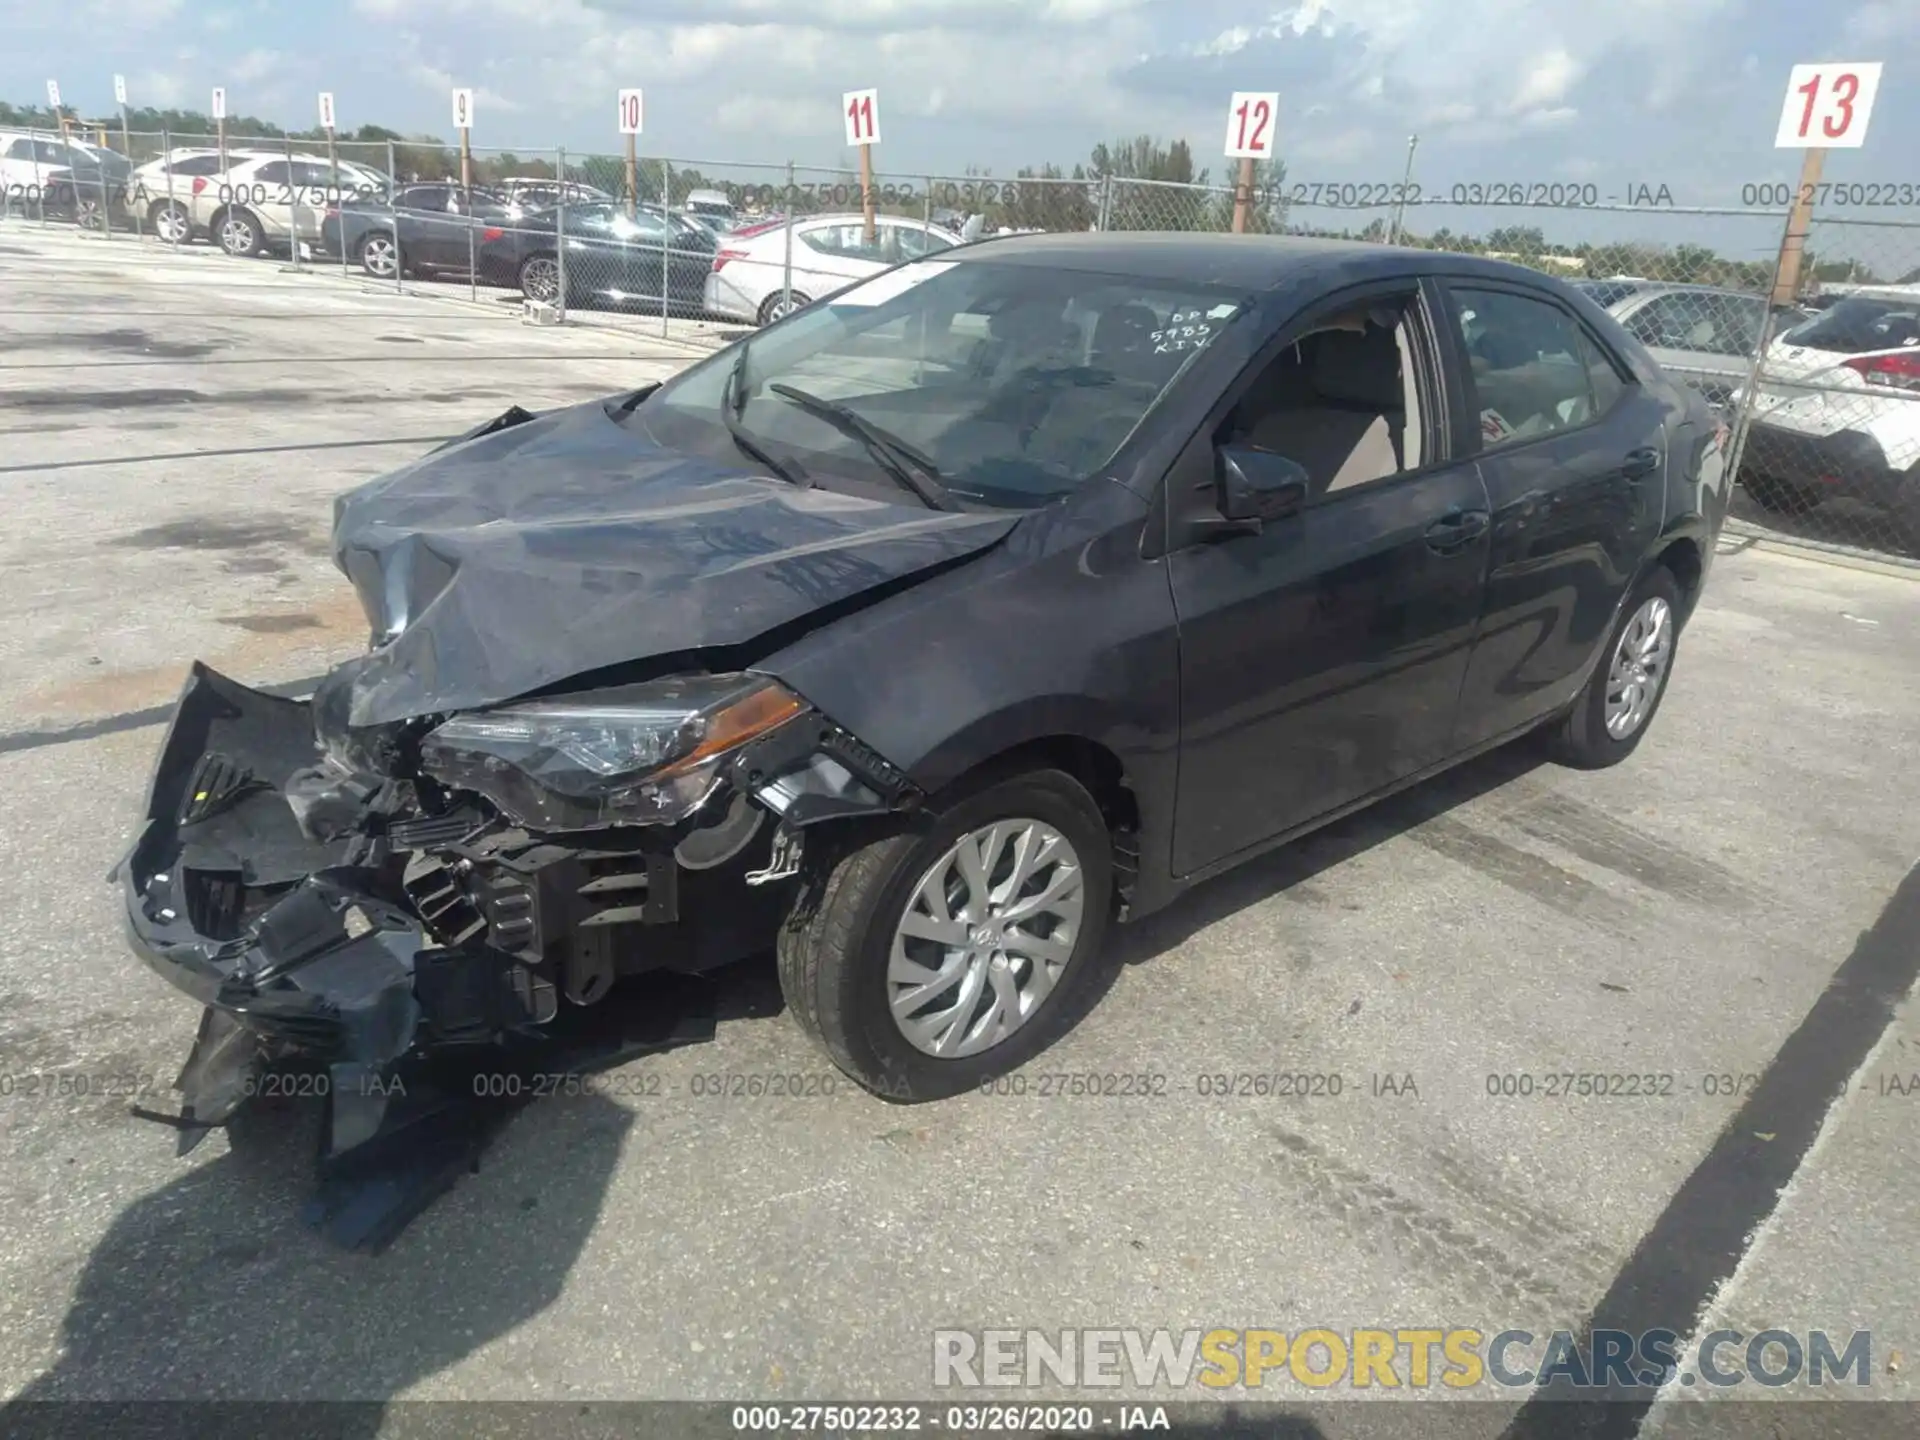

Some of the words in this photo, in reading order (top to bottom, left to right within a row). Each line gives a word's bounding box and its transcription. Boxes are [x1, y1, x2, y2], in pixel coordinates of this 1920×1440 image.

[458, 93, 466, 123] 9
[621, 95, 639, 128] 10
[848, 96, 873, 138] 11
[1236, 100, 1269, 150] 12
[1798, 73, 1859, 138] 13
